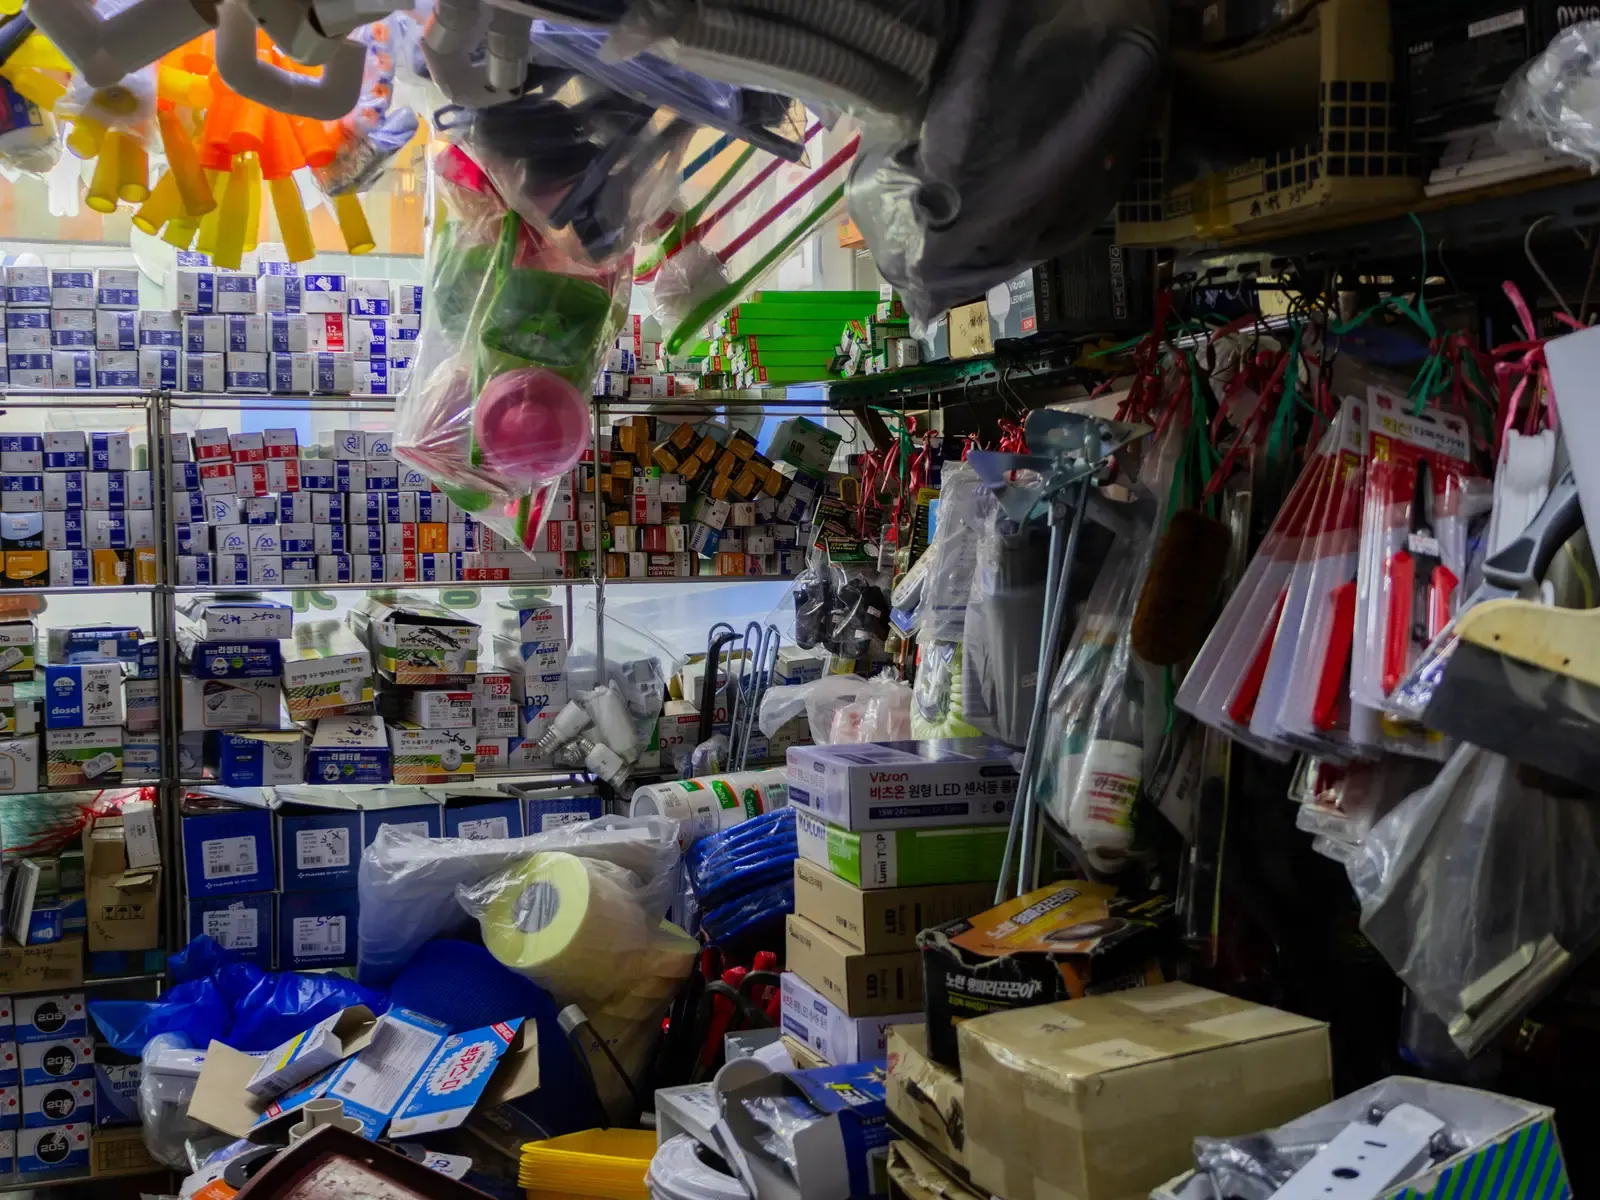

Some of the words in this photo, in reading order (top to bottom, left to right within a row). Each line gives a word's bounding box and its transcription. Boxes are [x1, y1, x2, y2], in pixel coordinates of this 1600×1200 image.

[526, 695, 549, 707] D32
[52, 706, 80, 715] dosel
[869, 772, 908, 783] Vitron
[870, 785, 905, 800] 비츠온
[909, 784, 932, 798] 원형
[935, 783, 961, 797] LED
[884, 909, 896, 934] LED
[866, 974, 878, 998] LED
